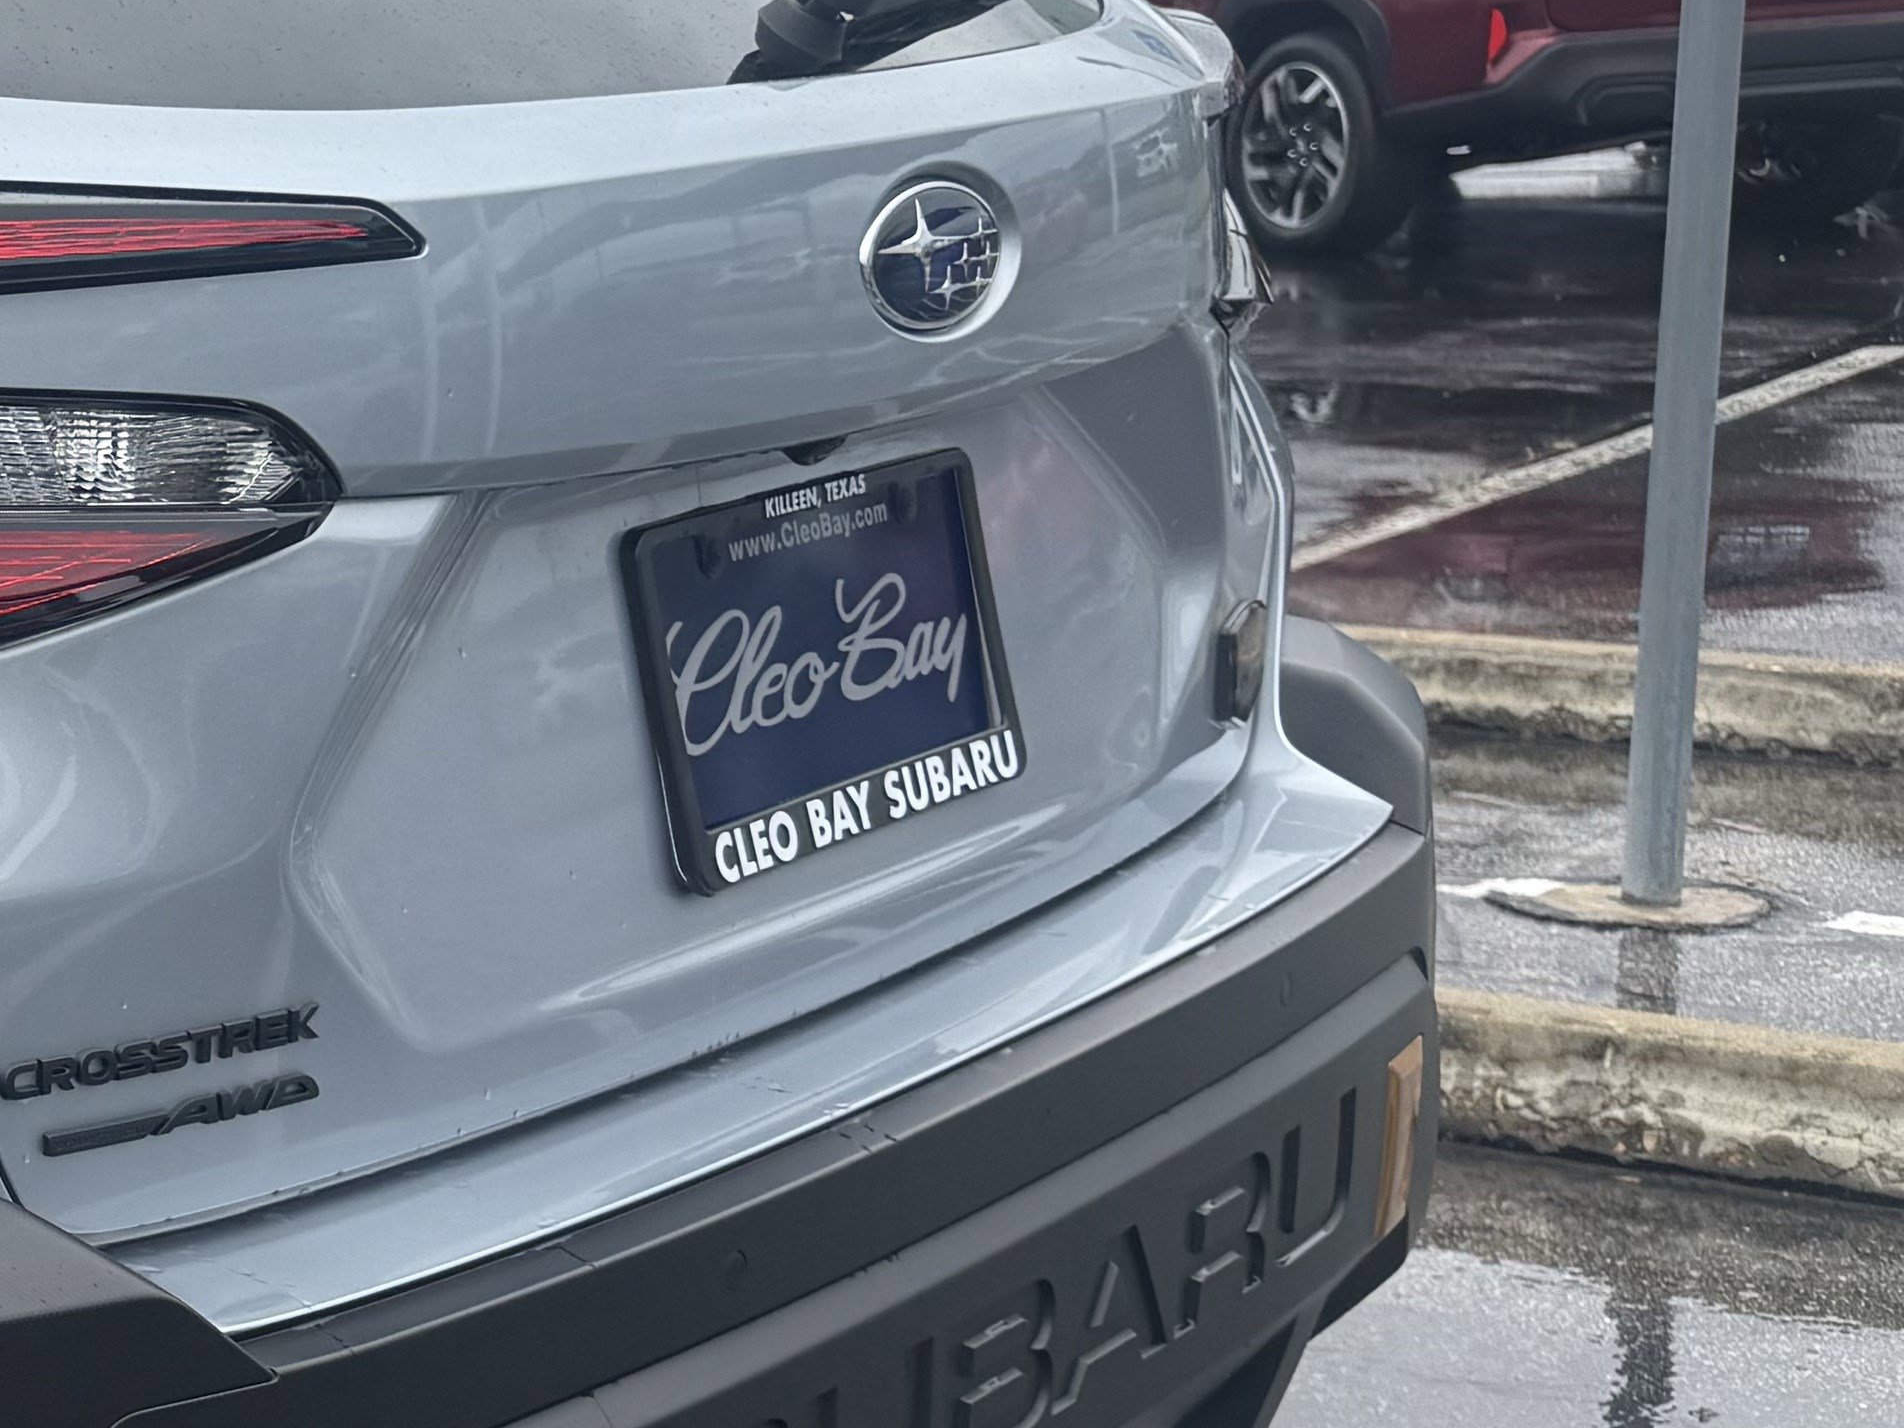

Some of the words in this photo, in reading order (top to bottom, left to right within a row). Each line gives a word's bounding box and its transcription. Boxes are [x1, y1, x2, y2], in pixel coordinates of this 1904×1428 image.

[765, 485, 821, 518] KILLEEN,
[824, 473, 866, 502] TEXAS
[728, 503, 888, 562] www.CleoBay.com
[665, 605, 841, 757] Cleo
[835, 572, 968, 703] Bay
[715, 810, 798, 883] CLEO
[806, 780, 870, 849] BAY
[884, 729, 1019, 819] SUBARU
[152, 1072, 320, 1135] AWD
